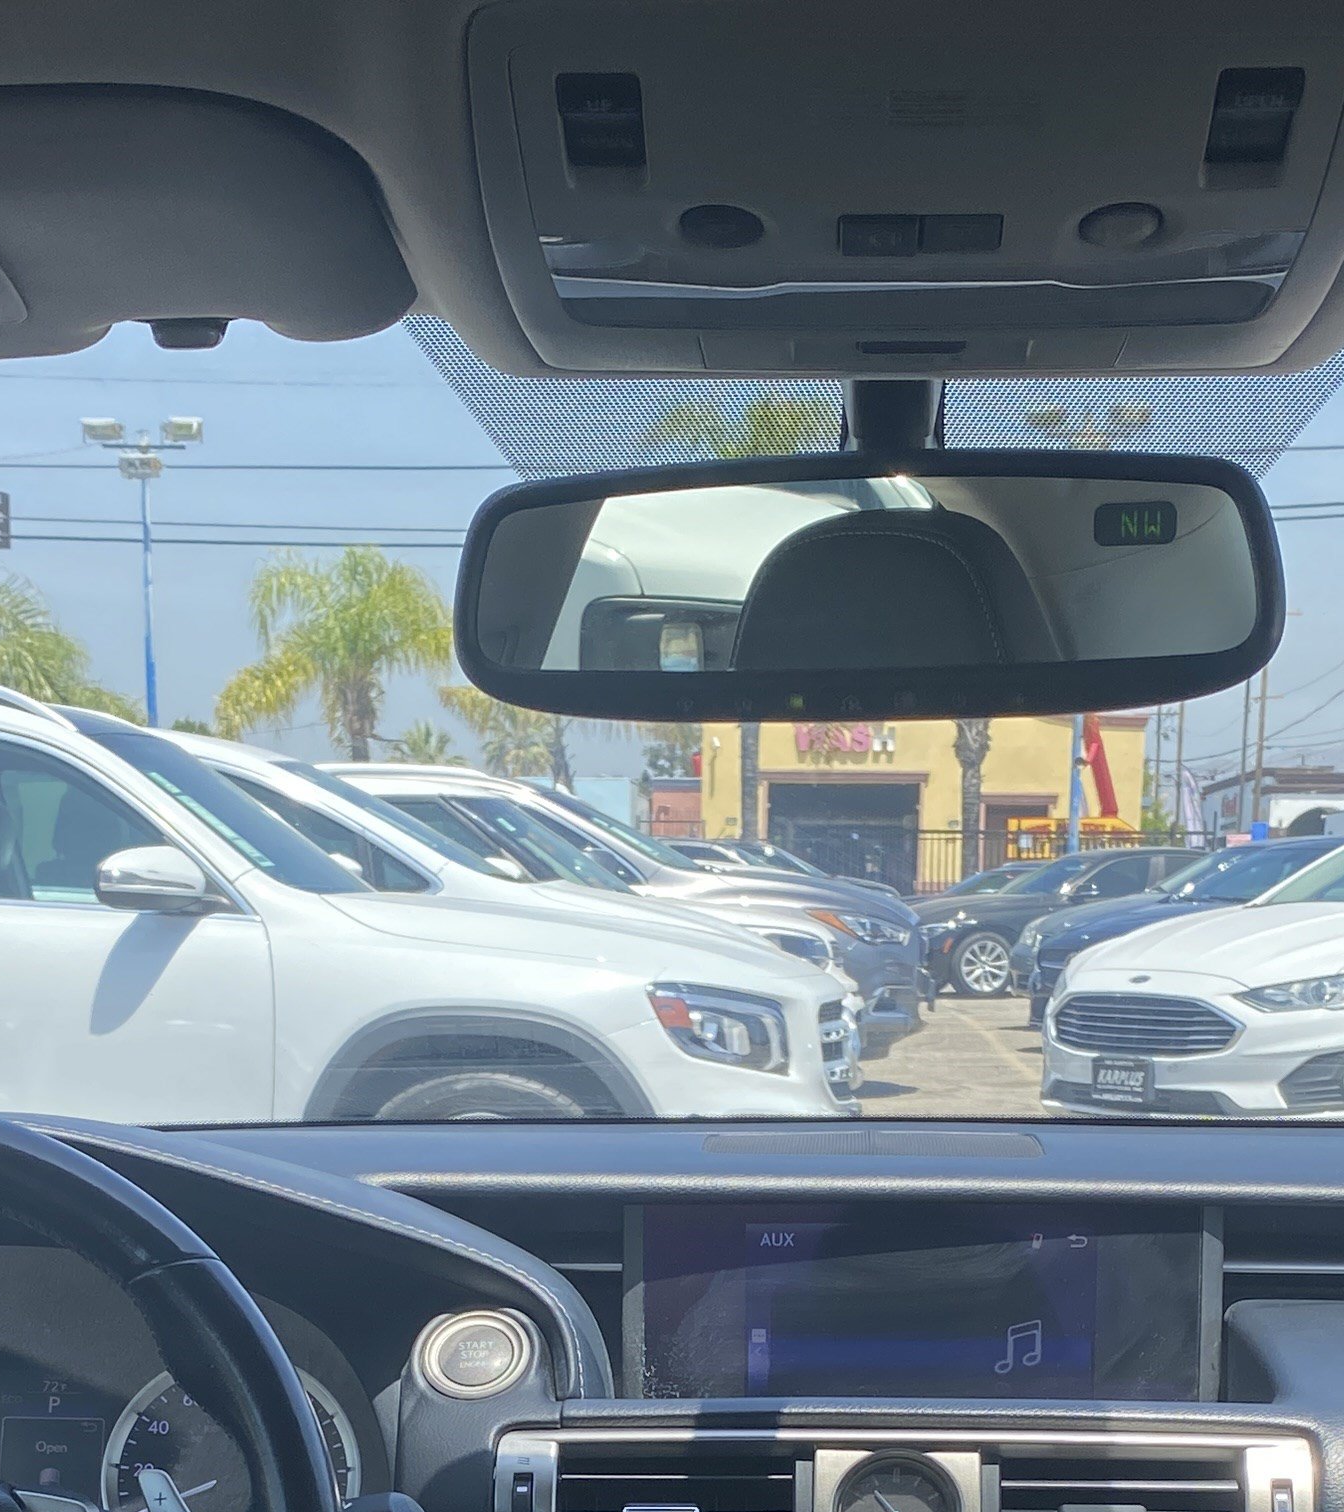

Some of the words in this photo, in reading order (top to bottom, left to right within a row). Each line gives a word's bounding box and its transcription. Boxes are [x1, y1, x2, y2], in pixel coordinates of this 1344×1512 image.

[1120, 511, 1161, 537] NW
[760, 1232, 795, 1247] AUX
[458, 1341, 494, 1351] START
[460, 1350, 490, 1360] STOP
[49, 1397, 61, 1414] P
[148, 1420, 170, 1435] 40
[36, 1441, 68, 1455] Open
